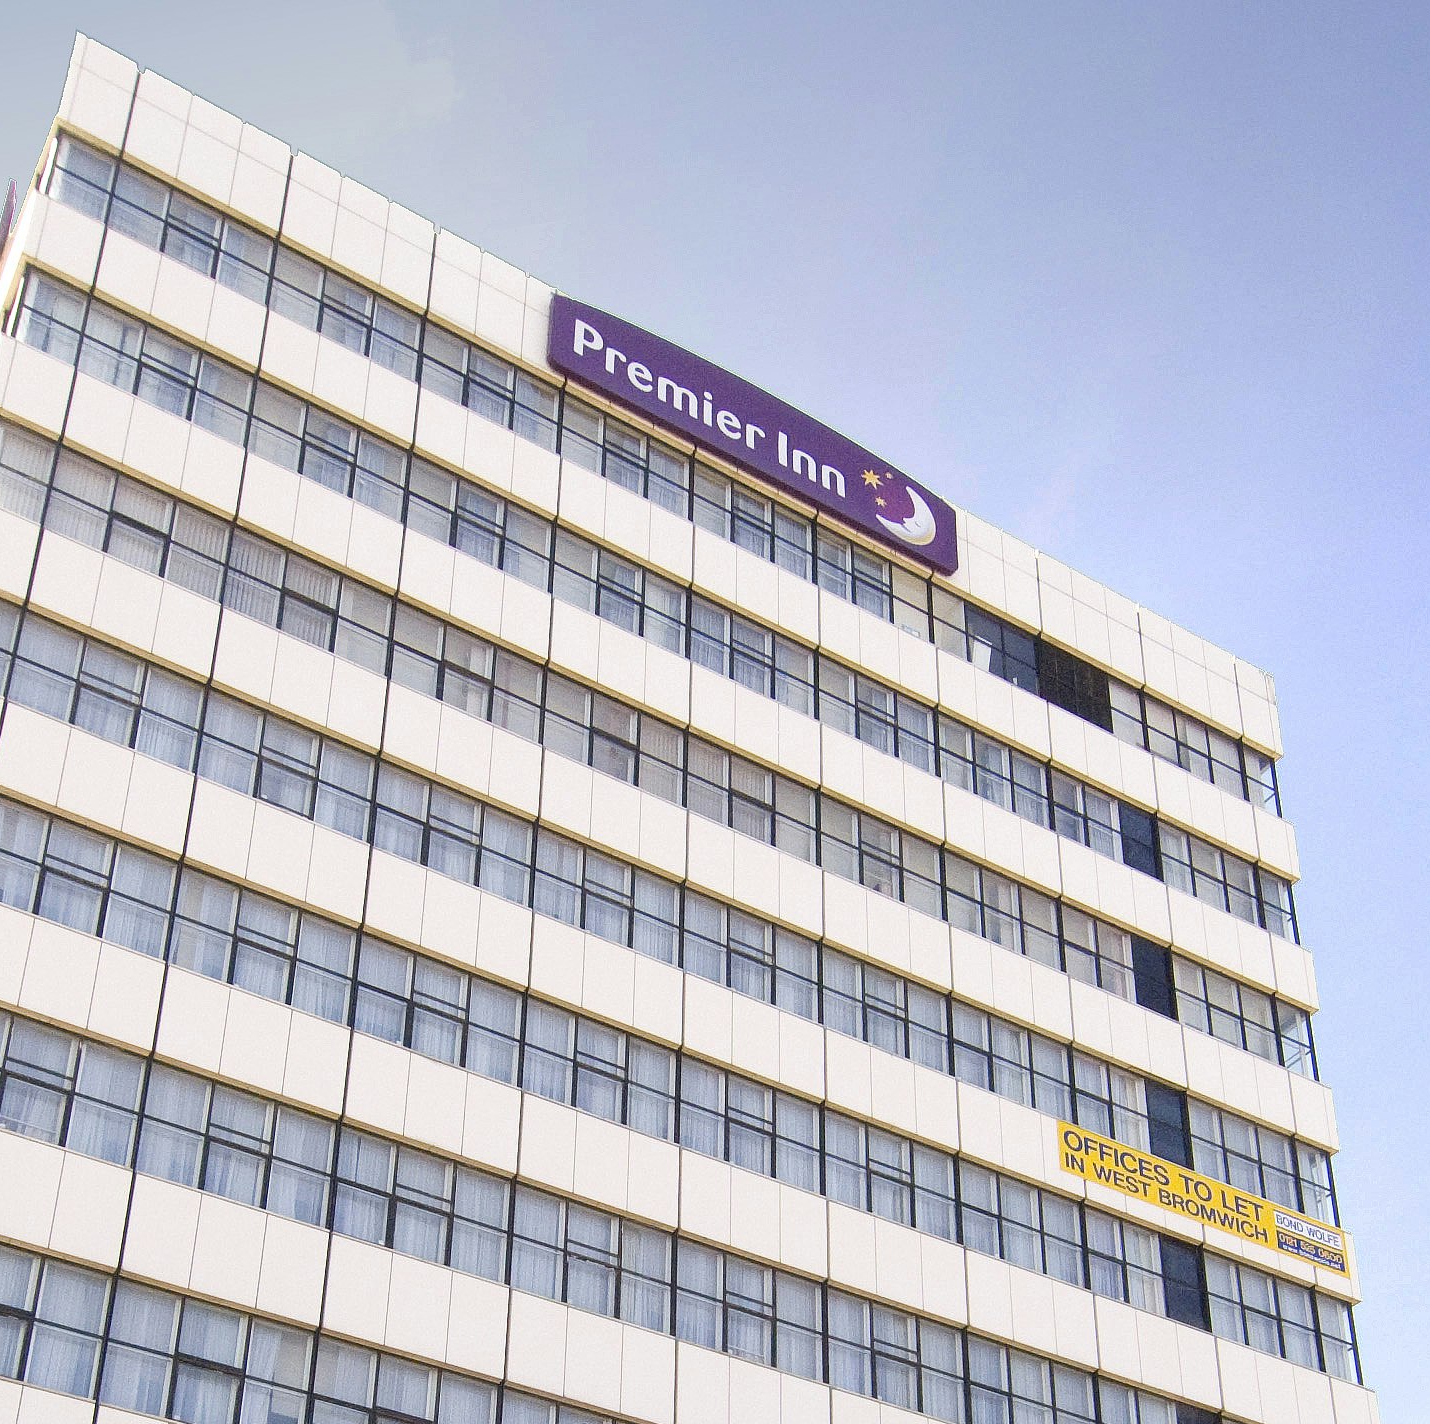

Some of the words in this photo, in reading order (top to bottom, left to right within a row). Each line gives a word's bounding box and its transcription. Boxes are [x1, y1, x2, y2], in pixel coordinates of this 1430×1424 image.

[573, 318, 766, 451] Premier
[777, 430, 847, 499] Inn
[1063, 1130, 1169, 1186] OFFICES
[1179, 1173, 1213, 1202] TO
[1221, 1189, 1263, 1222] LET
[1064, 1152, 1085, 1174] IN
[1093, 1163, 1151, 1198] WEST
[1158, 1187, 1269, 1244] BROMWICH
[1275, 1213, 1304, 1233] BOND
[1306, 1224, 1340, 1248] WOLFE
